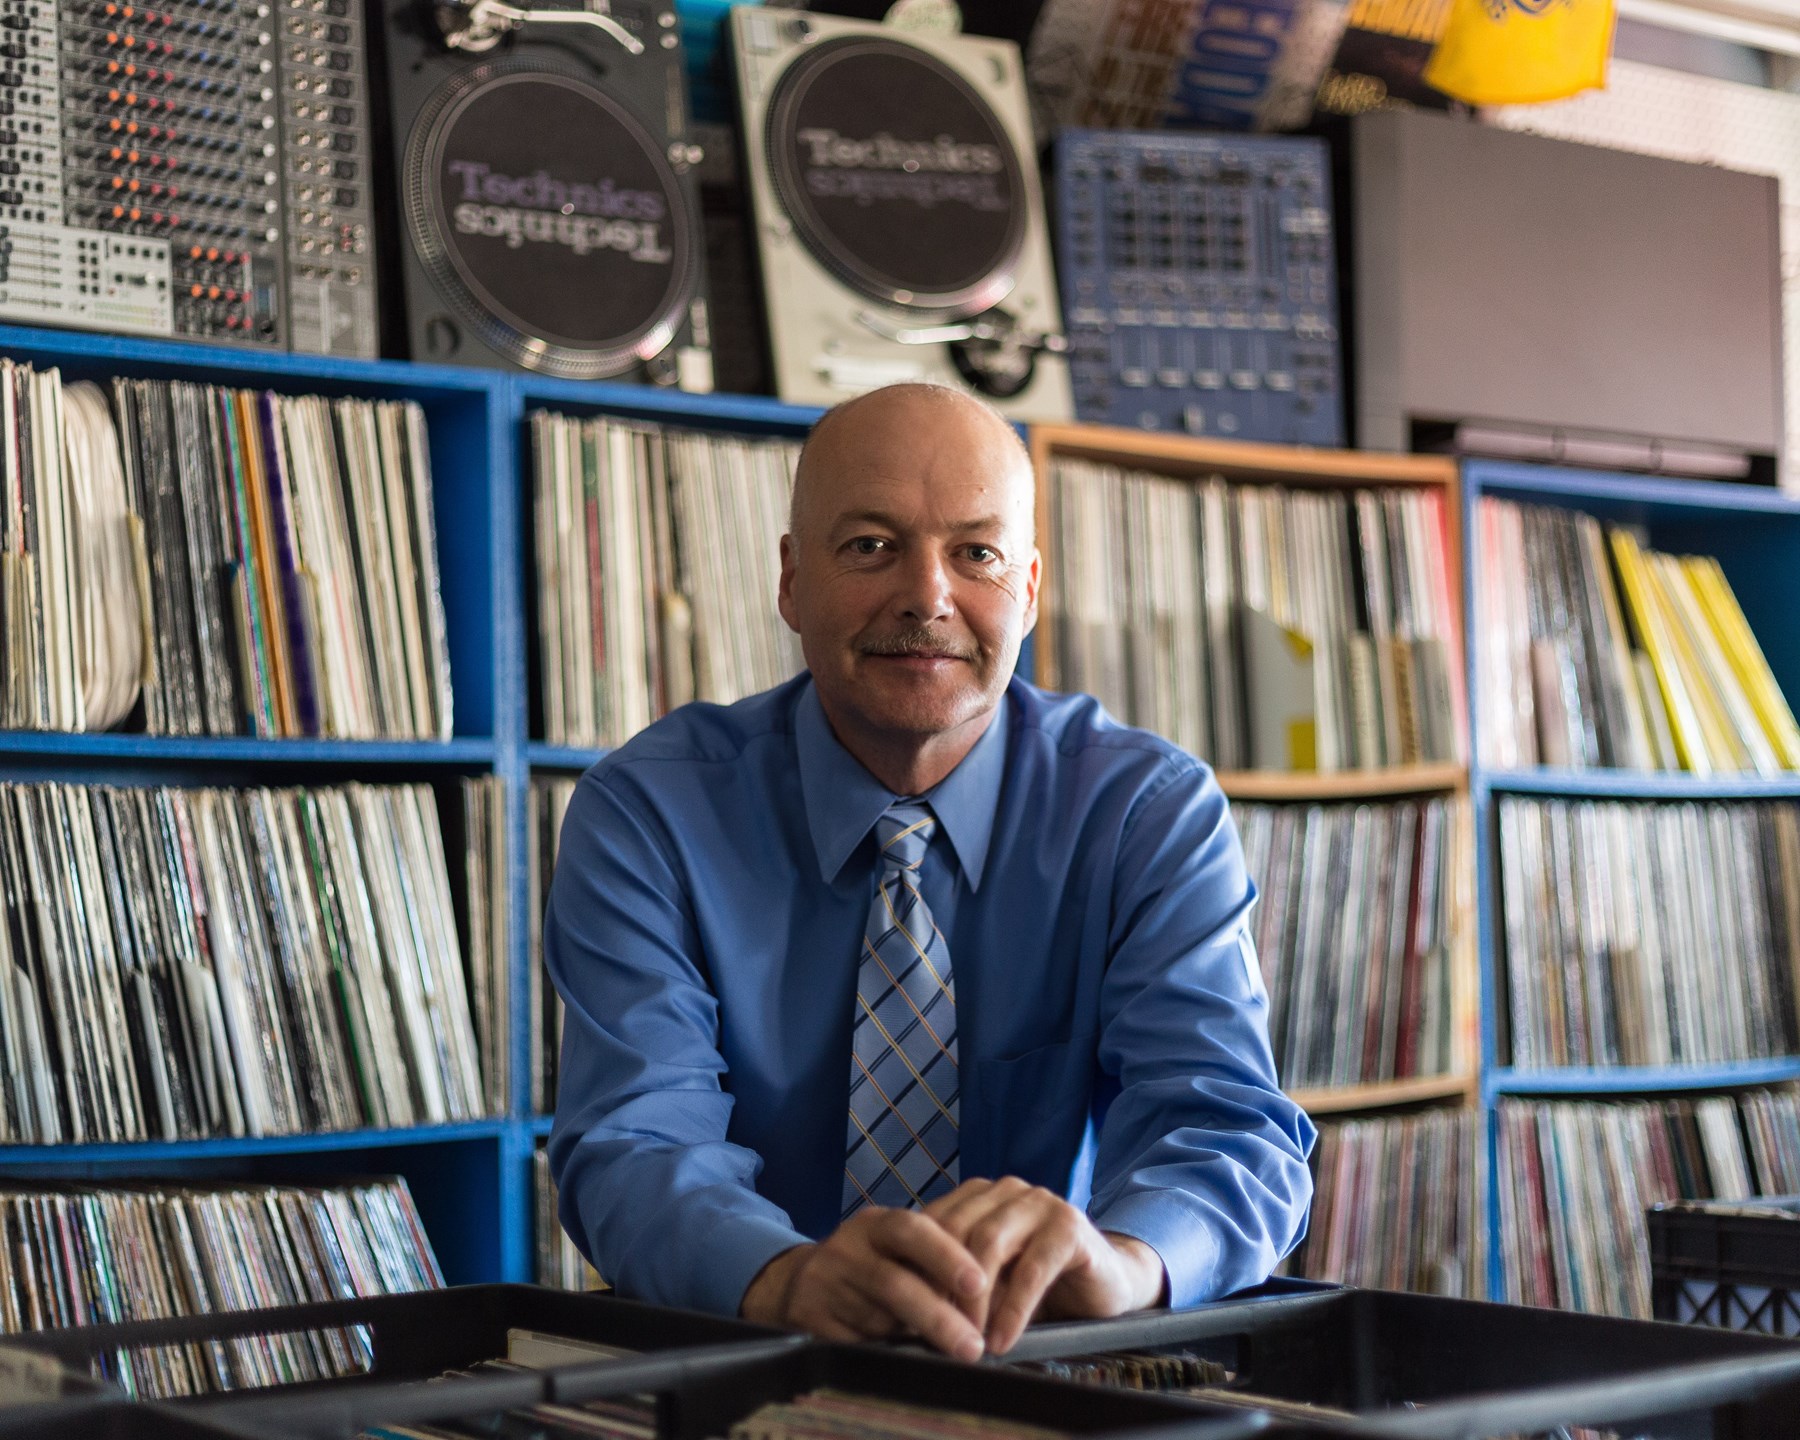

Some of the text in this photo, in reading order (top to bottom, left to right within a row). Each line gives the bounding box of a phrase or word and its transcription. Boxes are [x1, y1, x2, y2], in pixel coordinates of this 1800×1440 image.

[797, 127, 1003, 174] Technics
[450, 159, 666, 222] Technics
[454, 203, 672, 264] Technics
